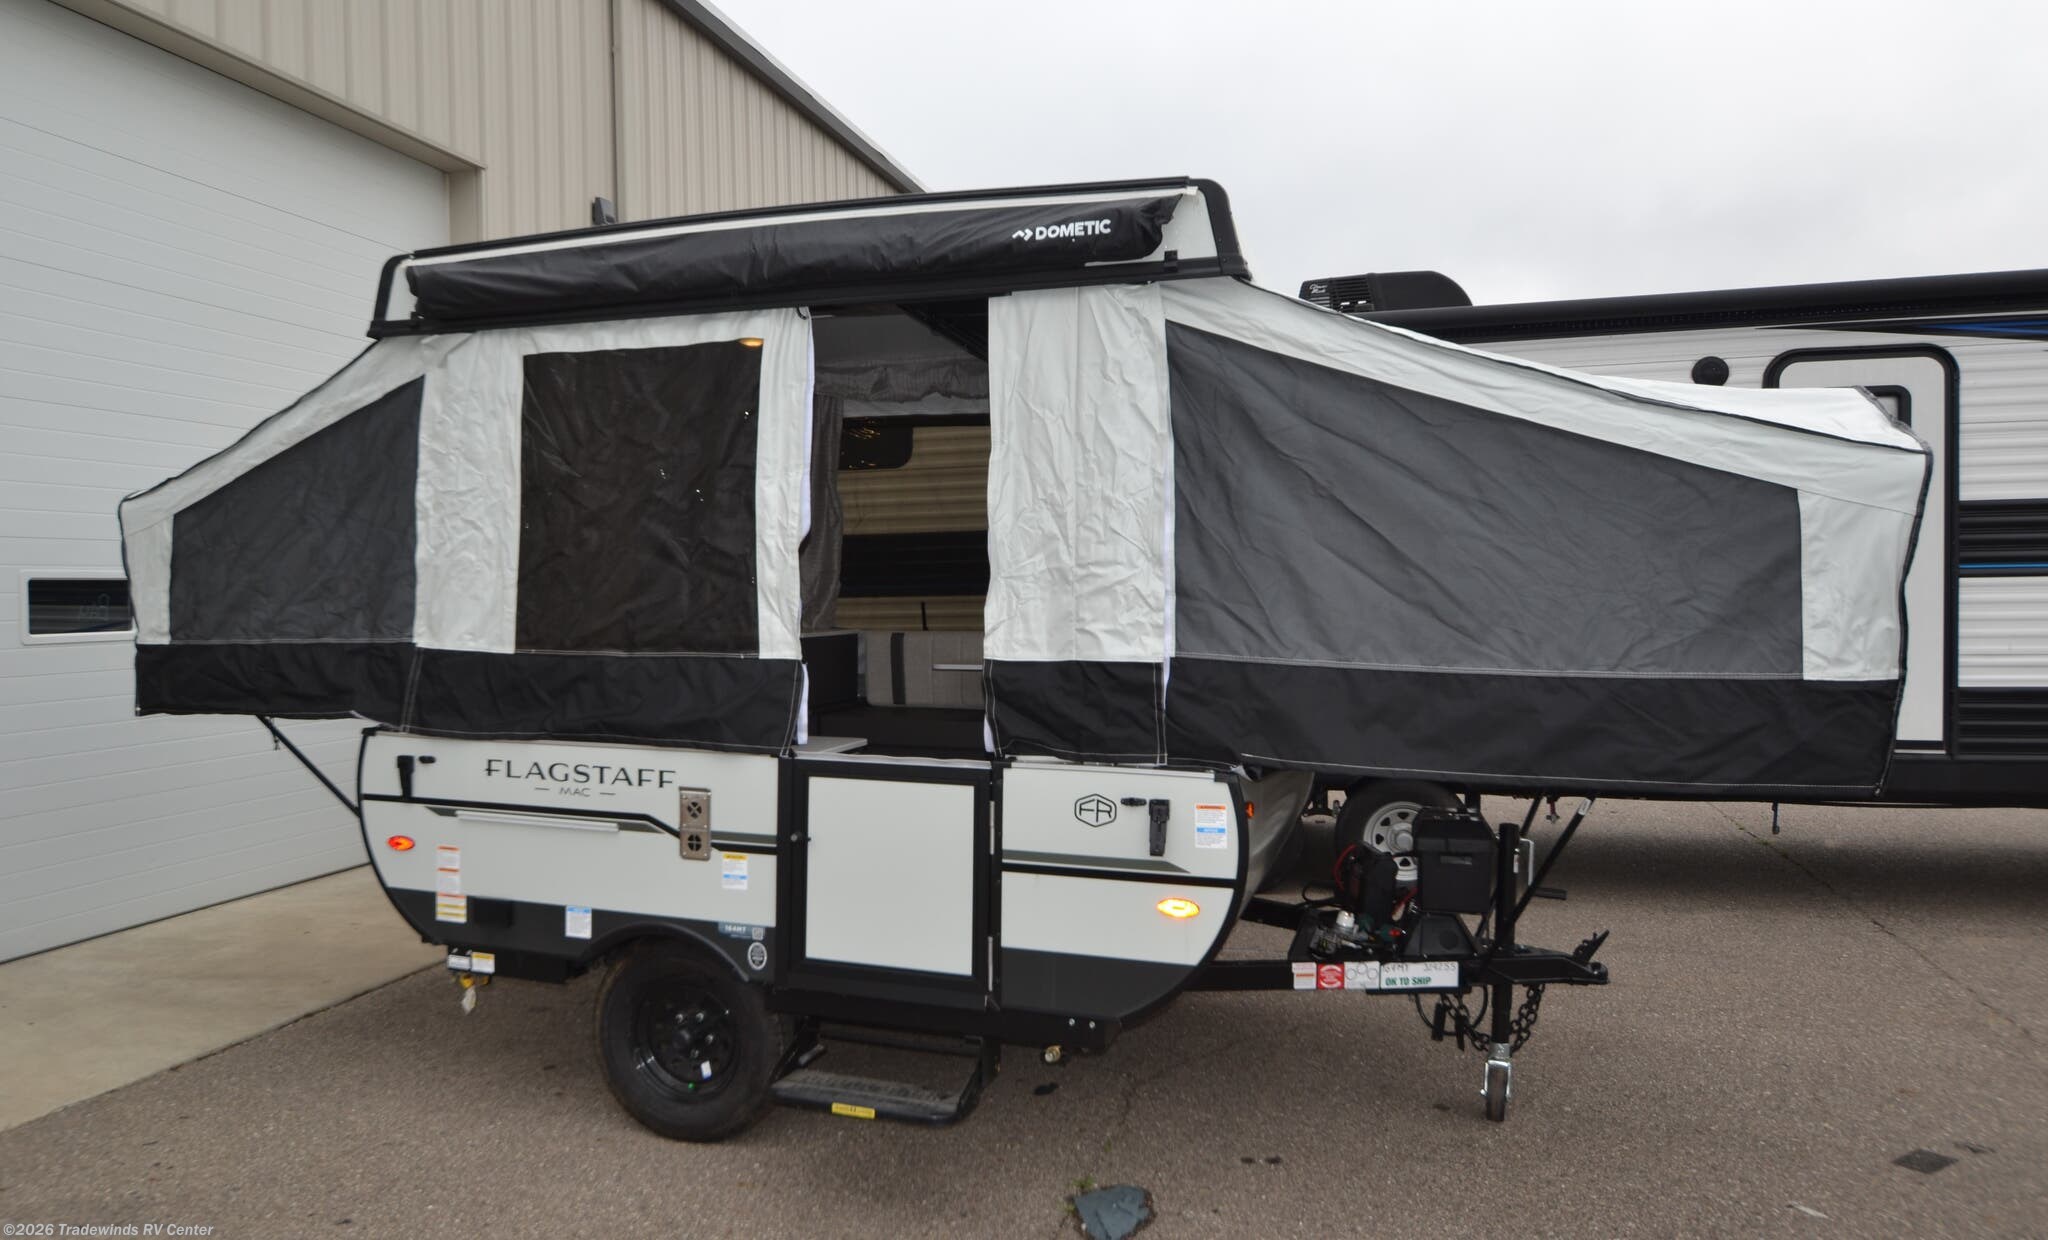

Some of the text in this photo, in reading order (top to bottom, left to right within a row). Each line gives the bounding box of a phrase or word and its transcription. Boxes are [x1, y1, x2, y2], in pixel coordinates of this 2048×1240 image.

[1035, 218, 1111, 240] DOMETIC
[485, 758, 676, 788] FLAGSTAFF
[559, 786, 591, 797] MAC
[1385, 976, 1397, 986] OK
[1399, 976, 1409, 986] TO
[1411, 975, 1432, 985] SHIP
